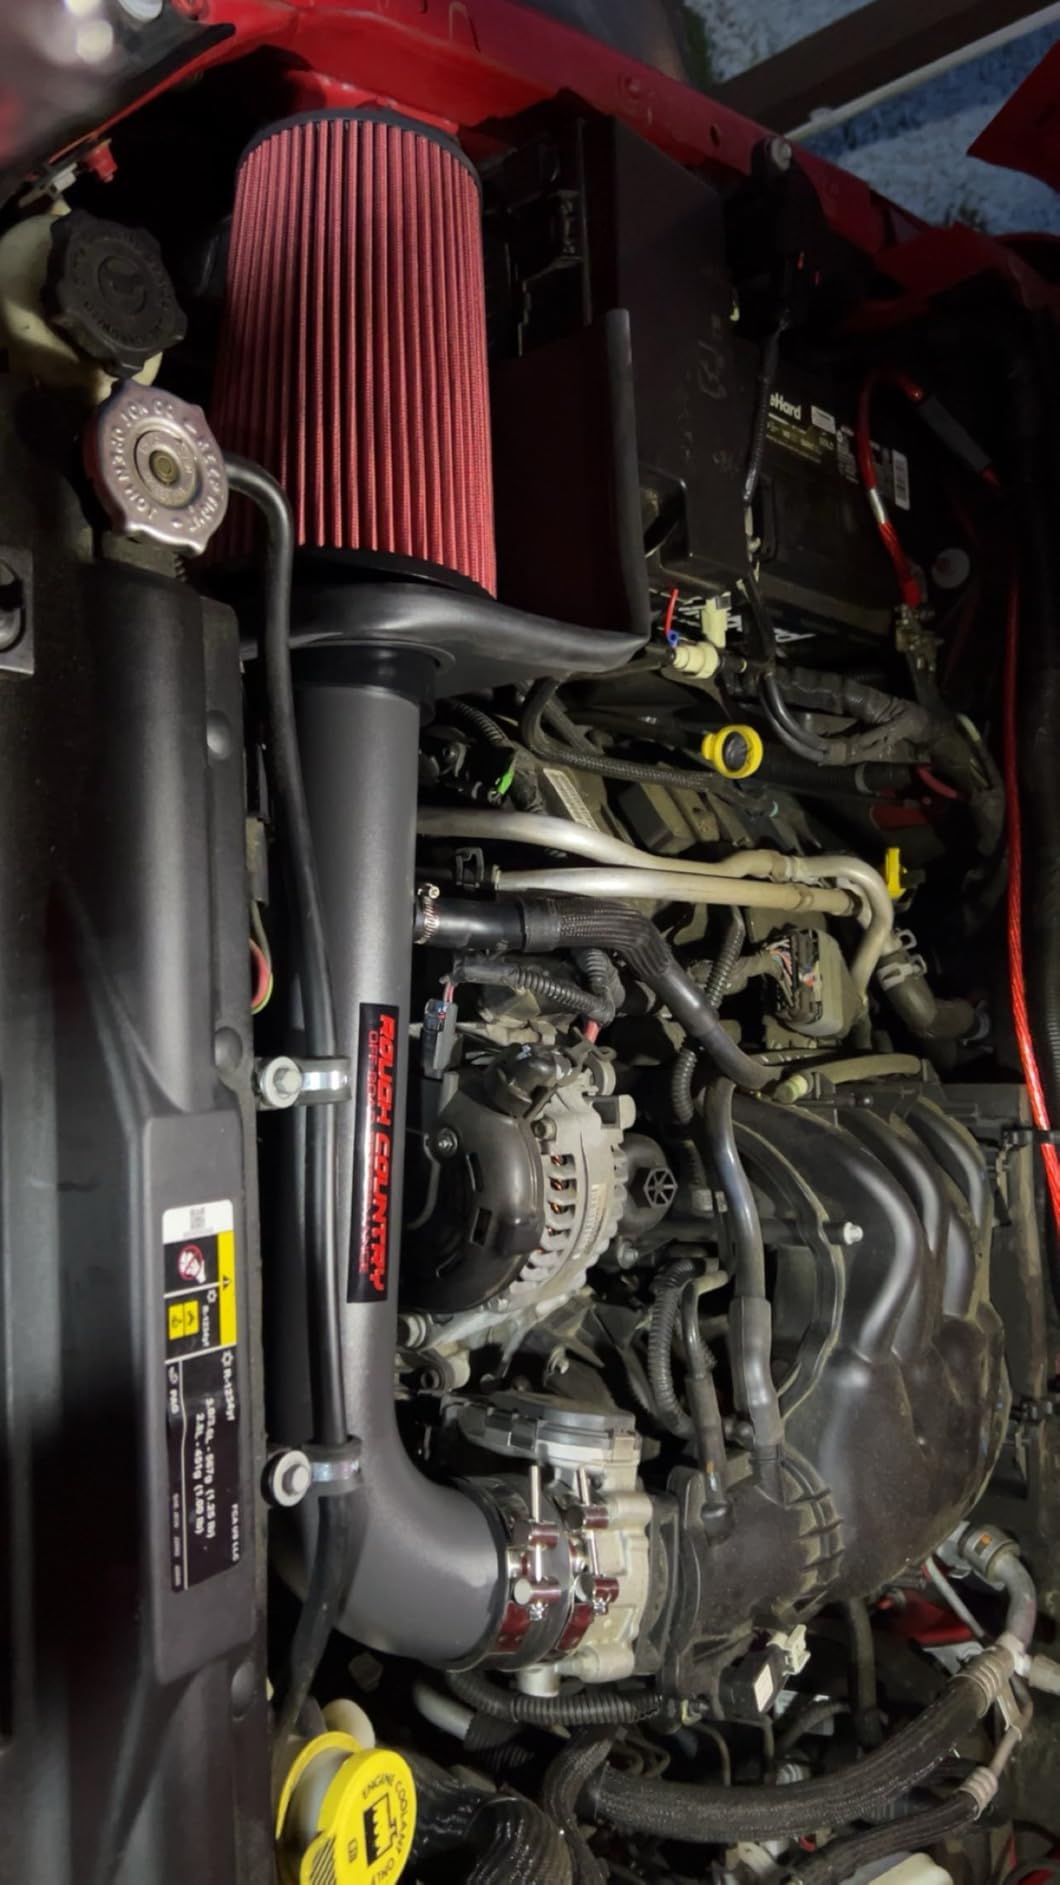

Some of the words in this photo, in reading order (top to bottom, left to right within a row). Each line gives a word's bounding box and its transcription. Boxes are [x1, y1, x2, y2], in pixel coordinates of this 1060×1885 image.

[769, 392, 802, 421] eHard
[376, 1014, 396, 1126] ROUGH
[369, 1132, 392, 1291] COUNTRY
[362, 1771, 396, 1800] ENGINE
[394, 1779, 408, 1854] COOLANT
